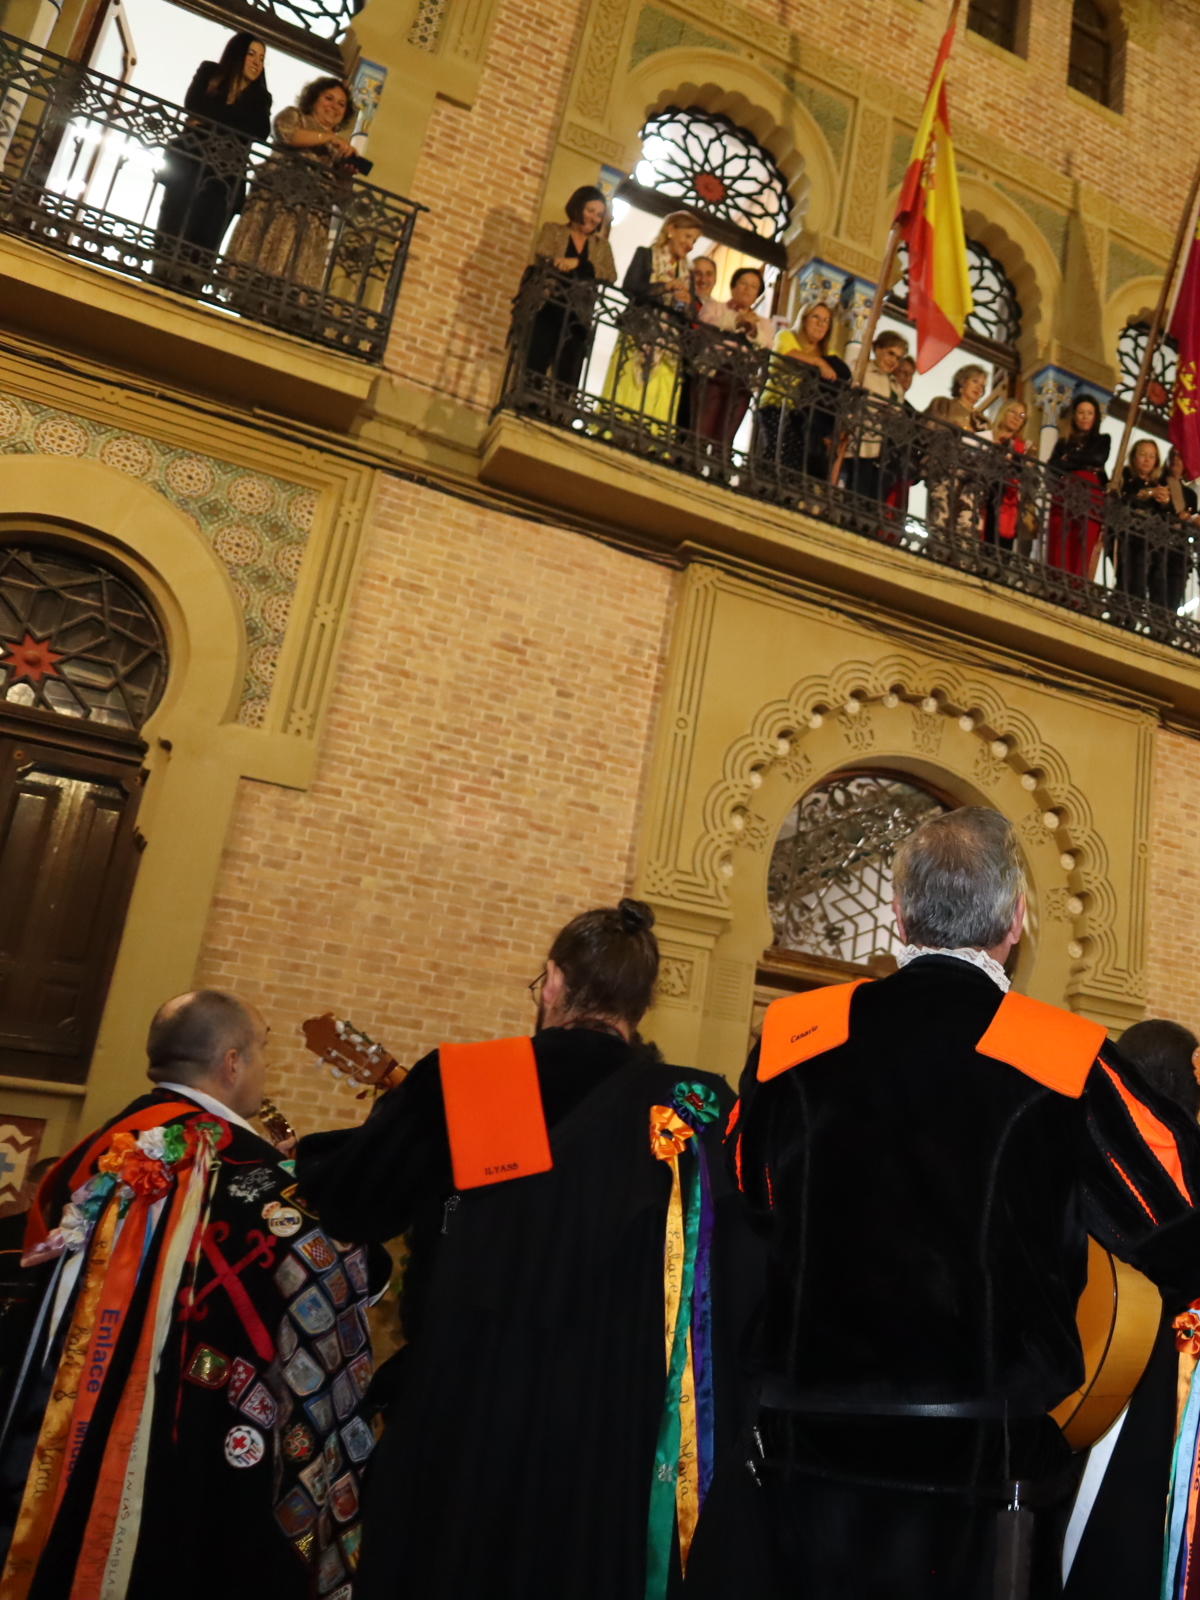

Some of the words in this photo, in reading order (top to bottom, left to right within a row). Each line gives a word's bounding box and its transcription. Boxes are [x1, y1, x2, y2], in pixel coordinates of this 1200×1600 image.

[484, 1162, 519, 1176] ILYASS
[86, 1308, 121, 1394] Enlace
[125, 1470, 136, 1491] EN
